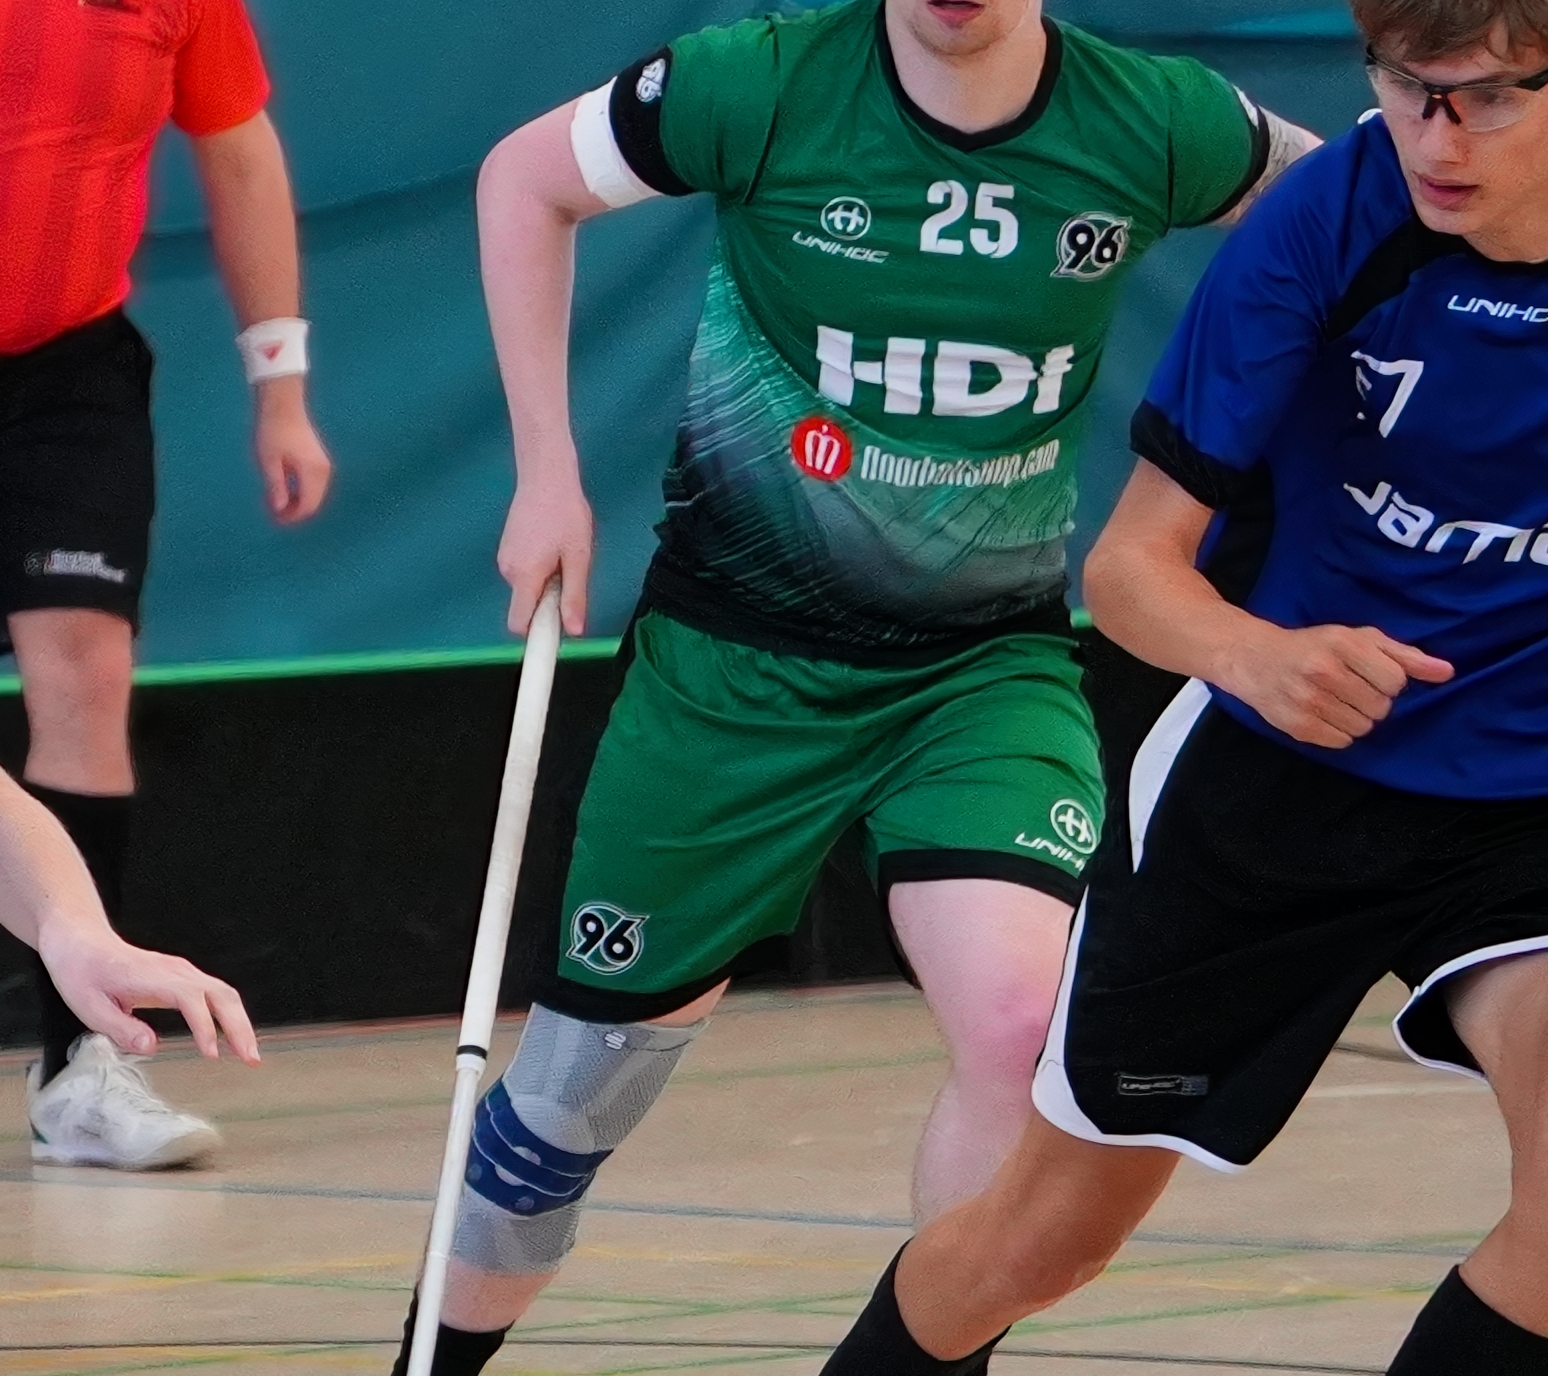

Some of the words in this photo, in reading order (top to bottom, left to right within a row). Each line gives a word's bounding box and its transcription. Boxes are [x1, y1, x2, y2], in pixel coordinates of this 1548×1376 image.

[920, 180, 1020, 259] 25
[1061, 219, 1128, 274] 96
[571, 909, 642, 965] 96
